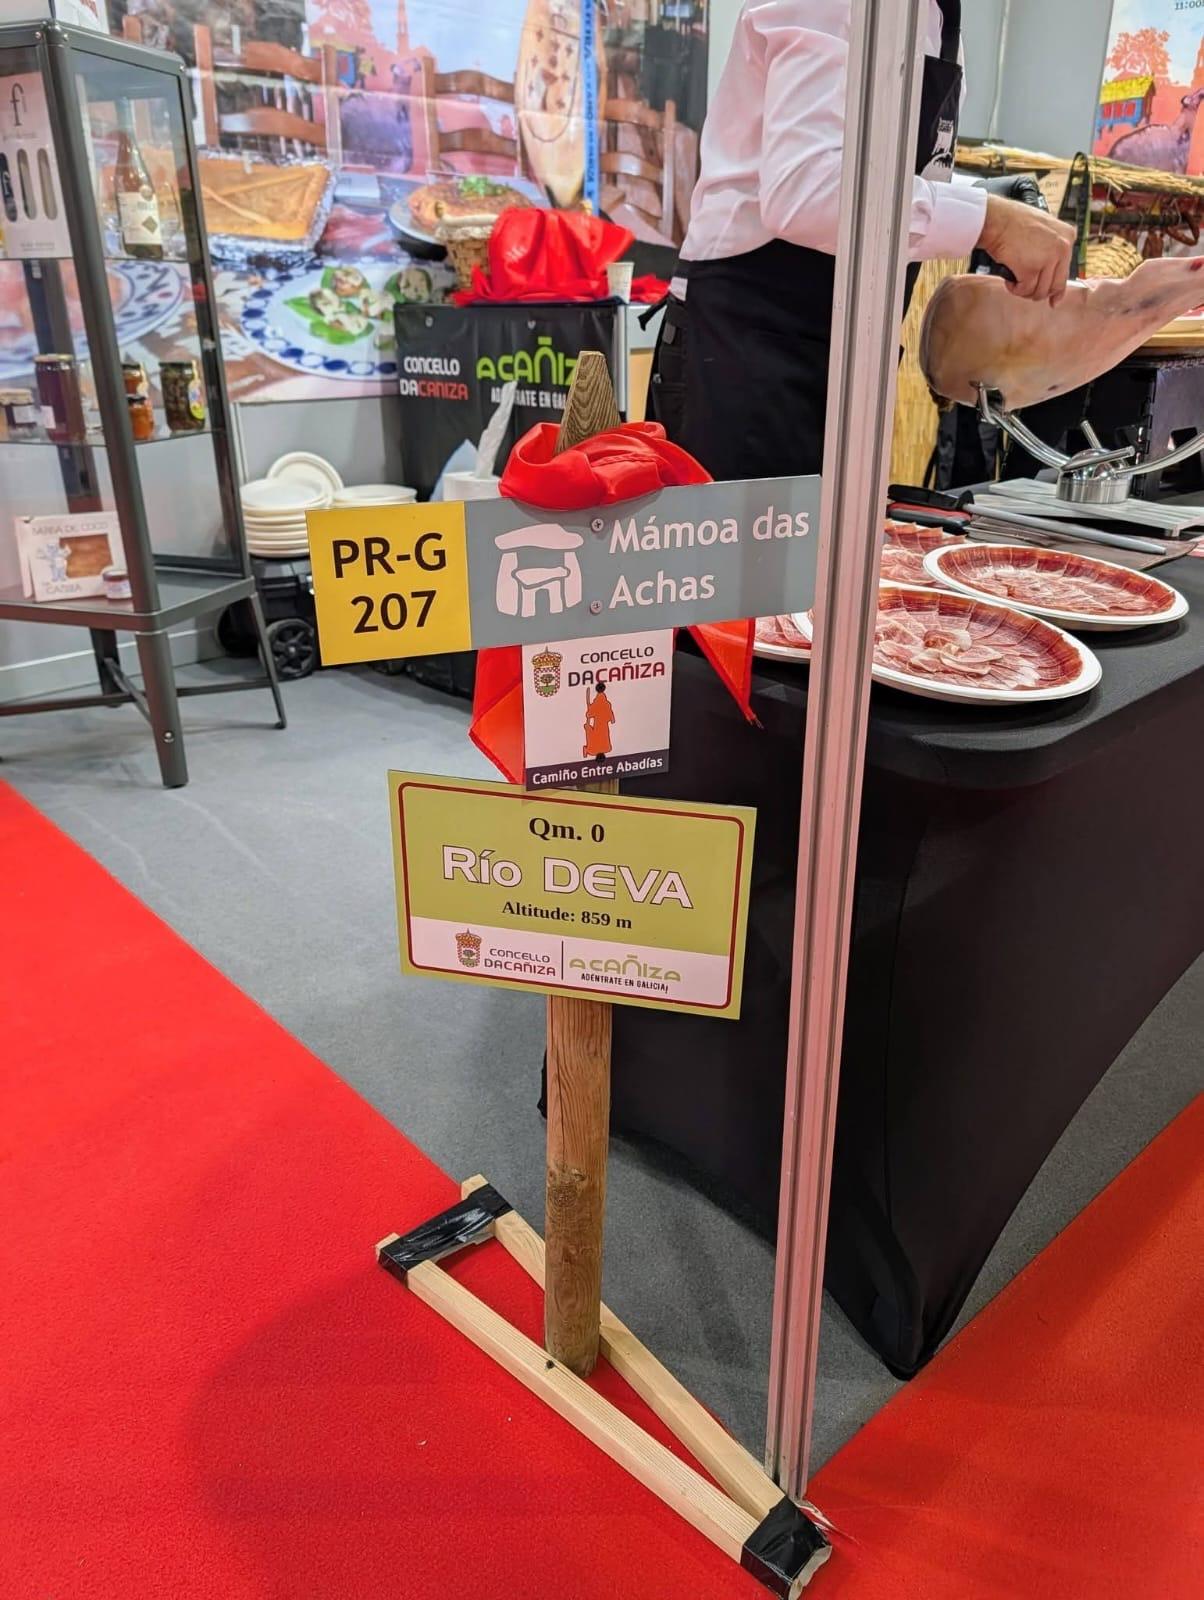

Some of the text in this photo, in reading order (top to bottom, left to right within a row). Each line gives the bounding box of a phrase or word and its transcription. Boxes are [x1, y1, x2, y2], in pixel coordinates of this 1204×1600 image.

[404, 356, 461, 376] CONCELLO
[609, 506, 811, 553] Mámoa das
[331, 532, 448, 580] PR-G
[609, 571, 716, 609] Achas
[350, 590, 438, 635] 207
[580, 646, 654, 664] CONCELLO
[532, 757, 663, 785] Camiño Entre Abadías
[529, 817, 605, 843] Qm. 0
[442, 845, 694, 910] Río DEVA
[502, 902, 633, 930] Altitude: 859 m
[484, 958, 556, 977] DACAÑIZA
[489, 948, 551, 963] CONCELLO
[625, 979, 634, 987] EN
